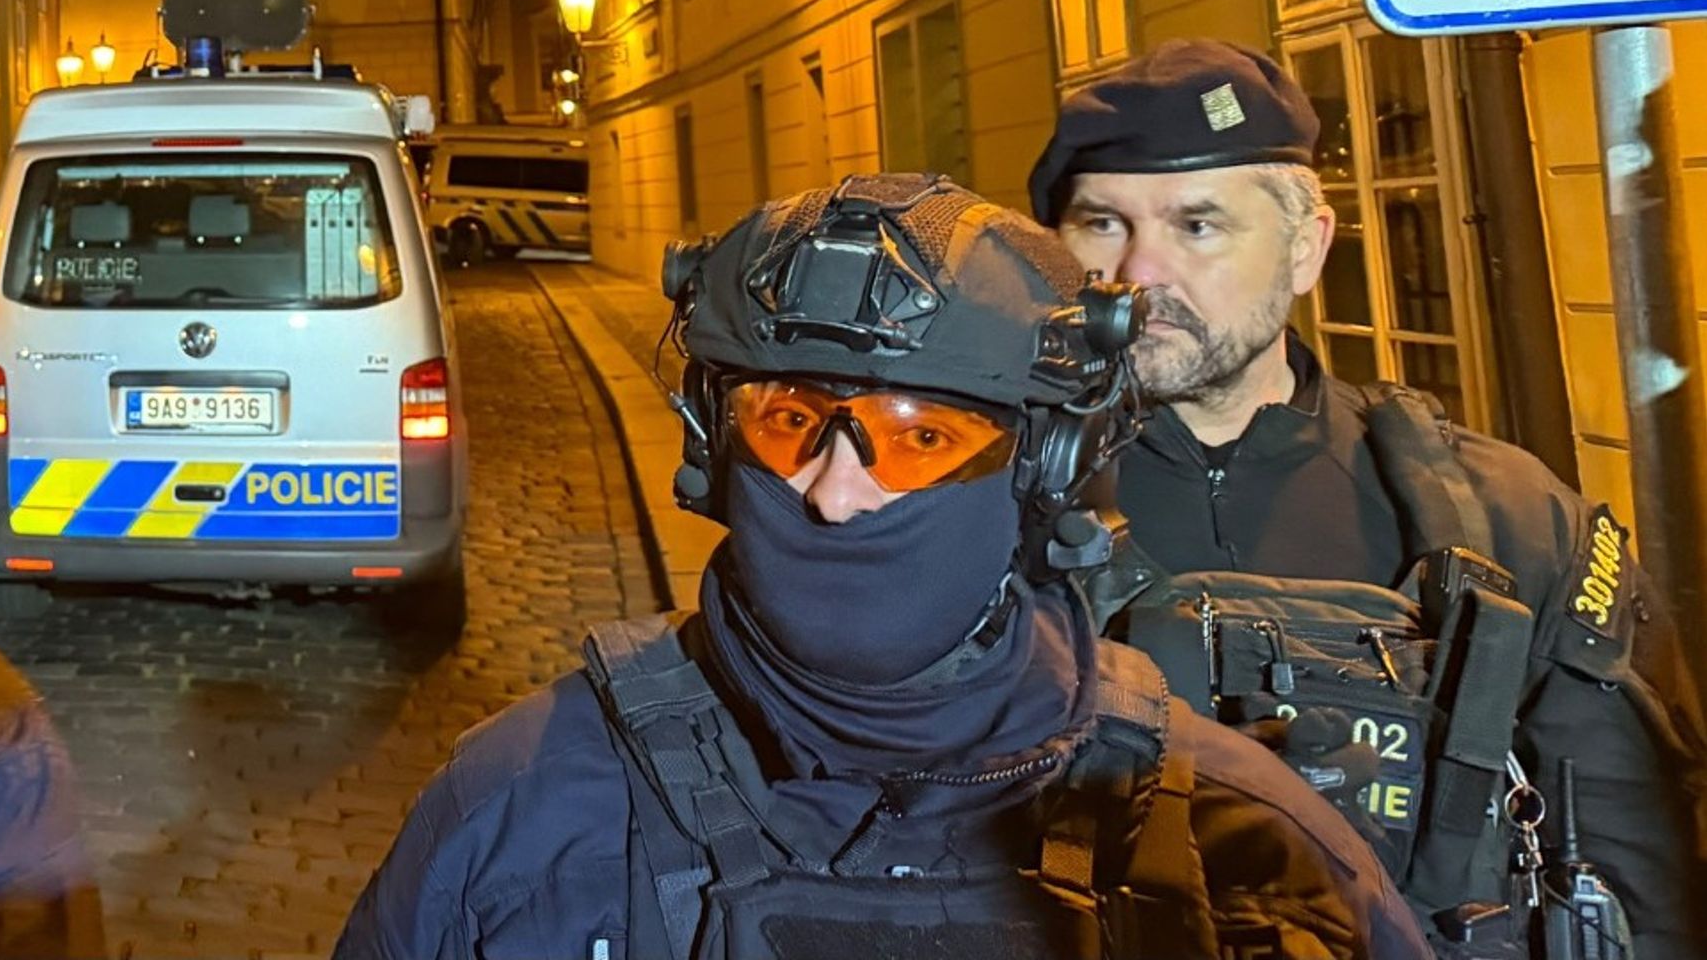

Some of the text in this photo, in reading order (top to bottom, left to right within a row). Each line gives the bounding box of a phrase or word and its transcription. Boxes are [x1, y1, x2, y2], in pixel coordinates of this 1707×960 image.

[147, 398, 187, 418] 9A9
[205, 398, 260, 419] 9136
[247, 471, 396, 505] POLICIE
[1575, 516, 1621, 625] 301402
